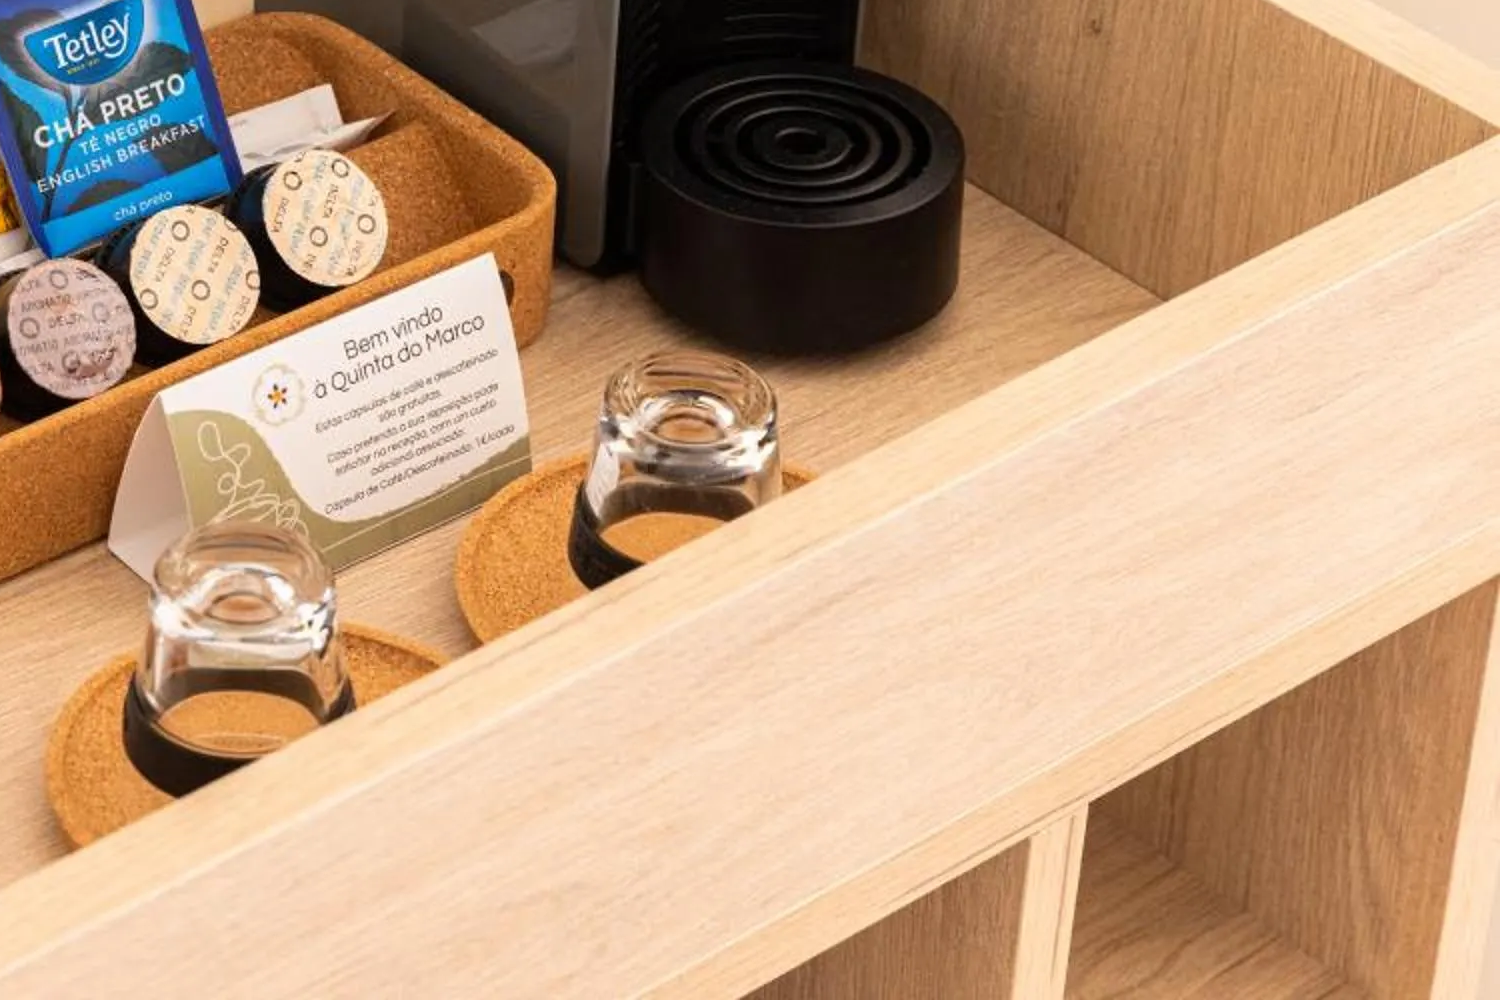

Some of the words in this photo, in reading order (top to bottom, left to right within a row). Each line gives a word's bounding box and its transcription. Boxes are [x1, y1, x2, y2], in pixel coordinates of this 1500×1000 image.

[43, 12, 130, 69] Tetley
[33, 105, 95, 149] CHÁ
[100, 73, 185, 123] PRETO
[80, 136, 101, 155] TÉ
[104, 113, 161, 146] NEGRO
[37, 155, 113, 194] ENGLISH
[116, 115, 207, 163] BREAKFAST
[114, 202, 137, 221] chá
[139, 191, 172, 215] preto
[314, 375, 328, 399] à
[331, 354, 395, 393] Quinta
[397, 342, 422, 364] do
[425, 315, 485, 352] Marco
[343, 329, 389, 360] Bem
[391, 306, 443, 337] vindo
[315, 413, 343, 434] Estas
[390, 387, 402, 401] de
[434, 348, 499, 382] descafeinado
[378, 409, 396, 423] são
[327, 449, 353, 464] Caso
[408, 416, 425, 430] sua
[474, 382, 499, 400] pode
[373, 446, 387, 458] na
[429, 420, 451, 435] com
[452, 411, 469, 425] um
[470, 399, 497, 416] custo
[366, 484, 379, 497] de
